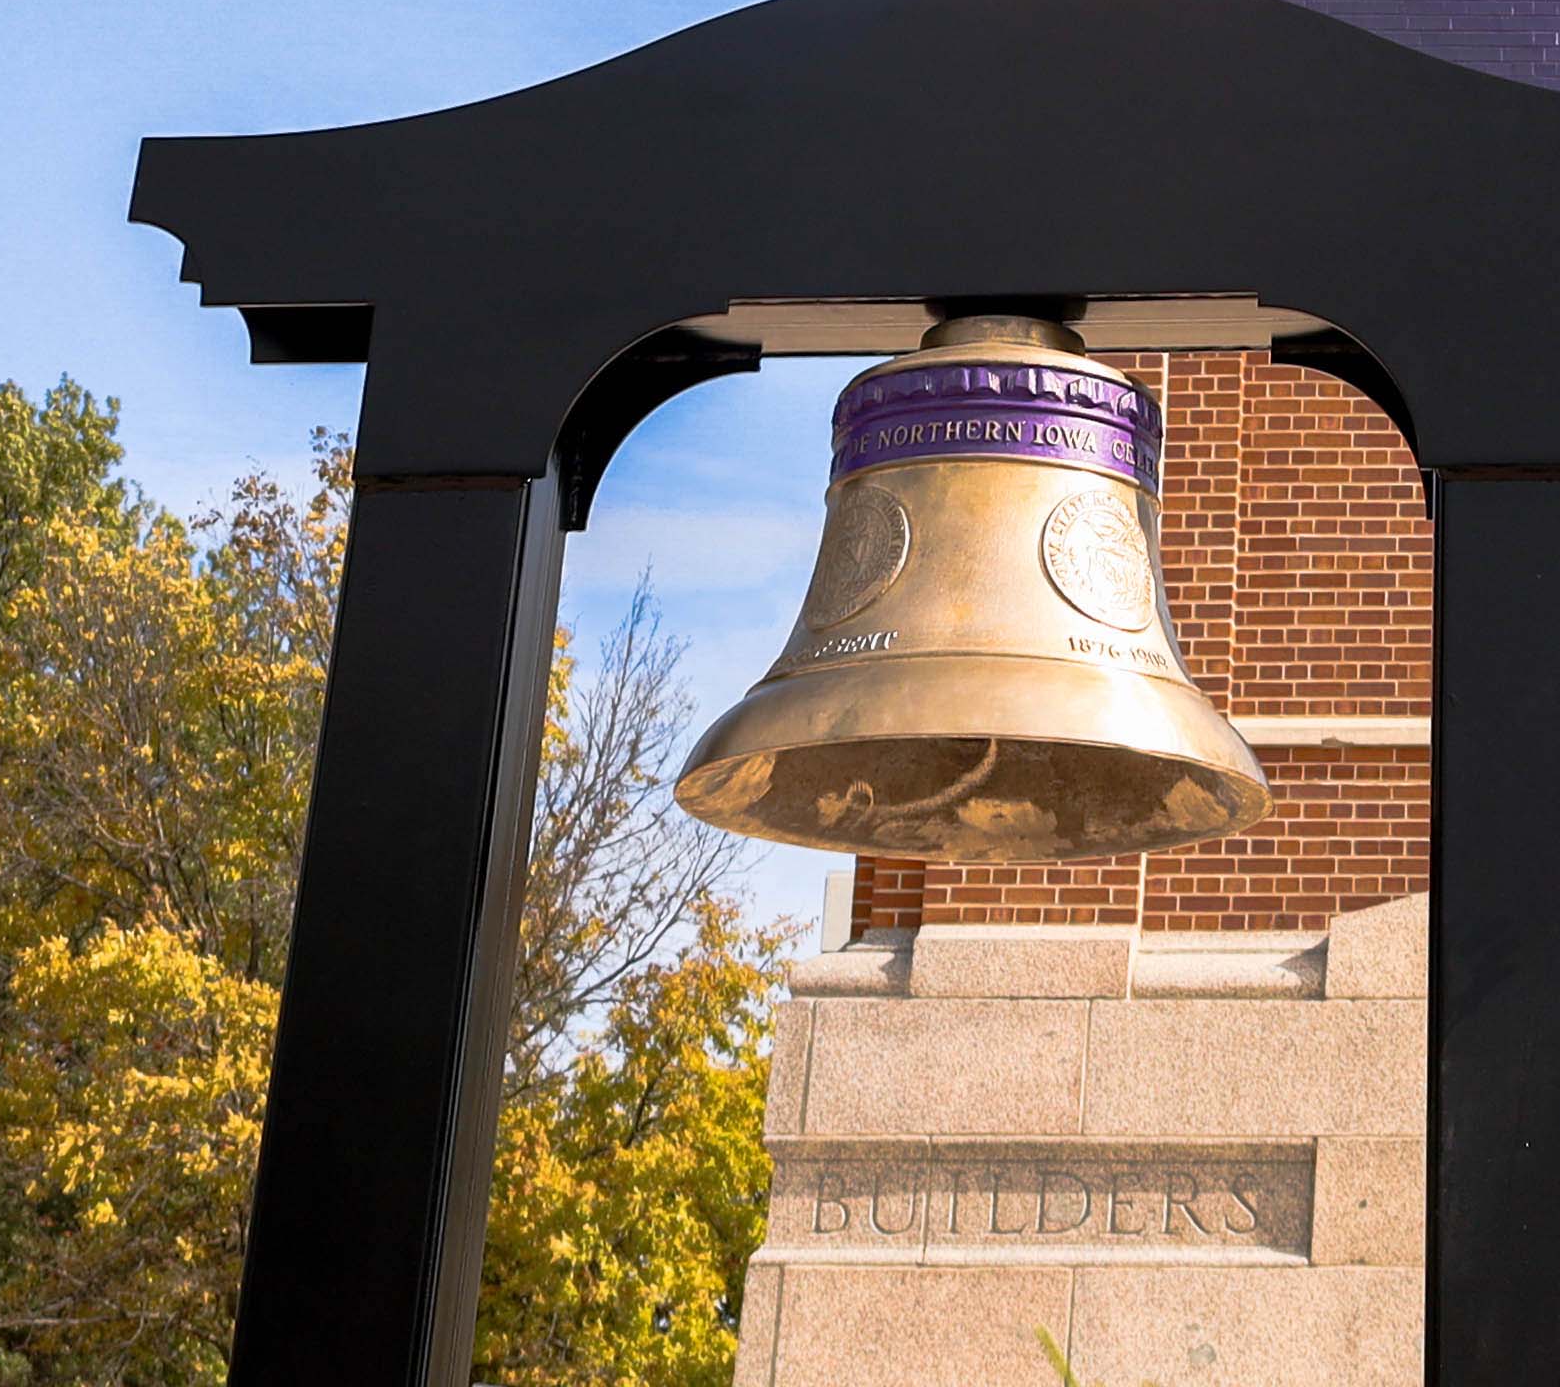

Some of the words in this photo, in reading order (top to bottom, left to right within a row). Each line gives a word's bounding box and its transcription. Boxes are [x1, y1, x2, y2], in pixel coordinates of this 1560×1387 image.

[878, 419, 1023, 450] NORTHERN
[1033, 422, 1097, 453] IOWA
[810, 1170, 1260, 1236] BUILDERS
